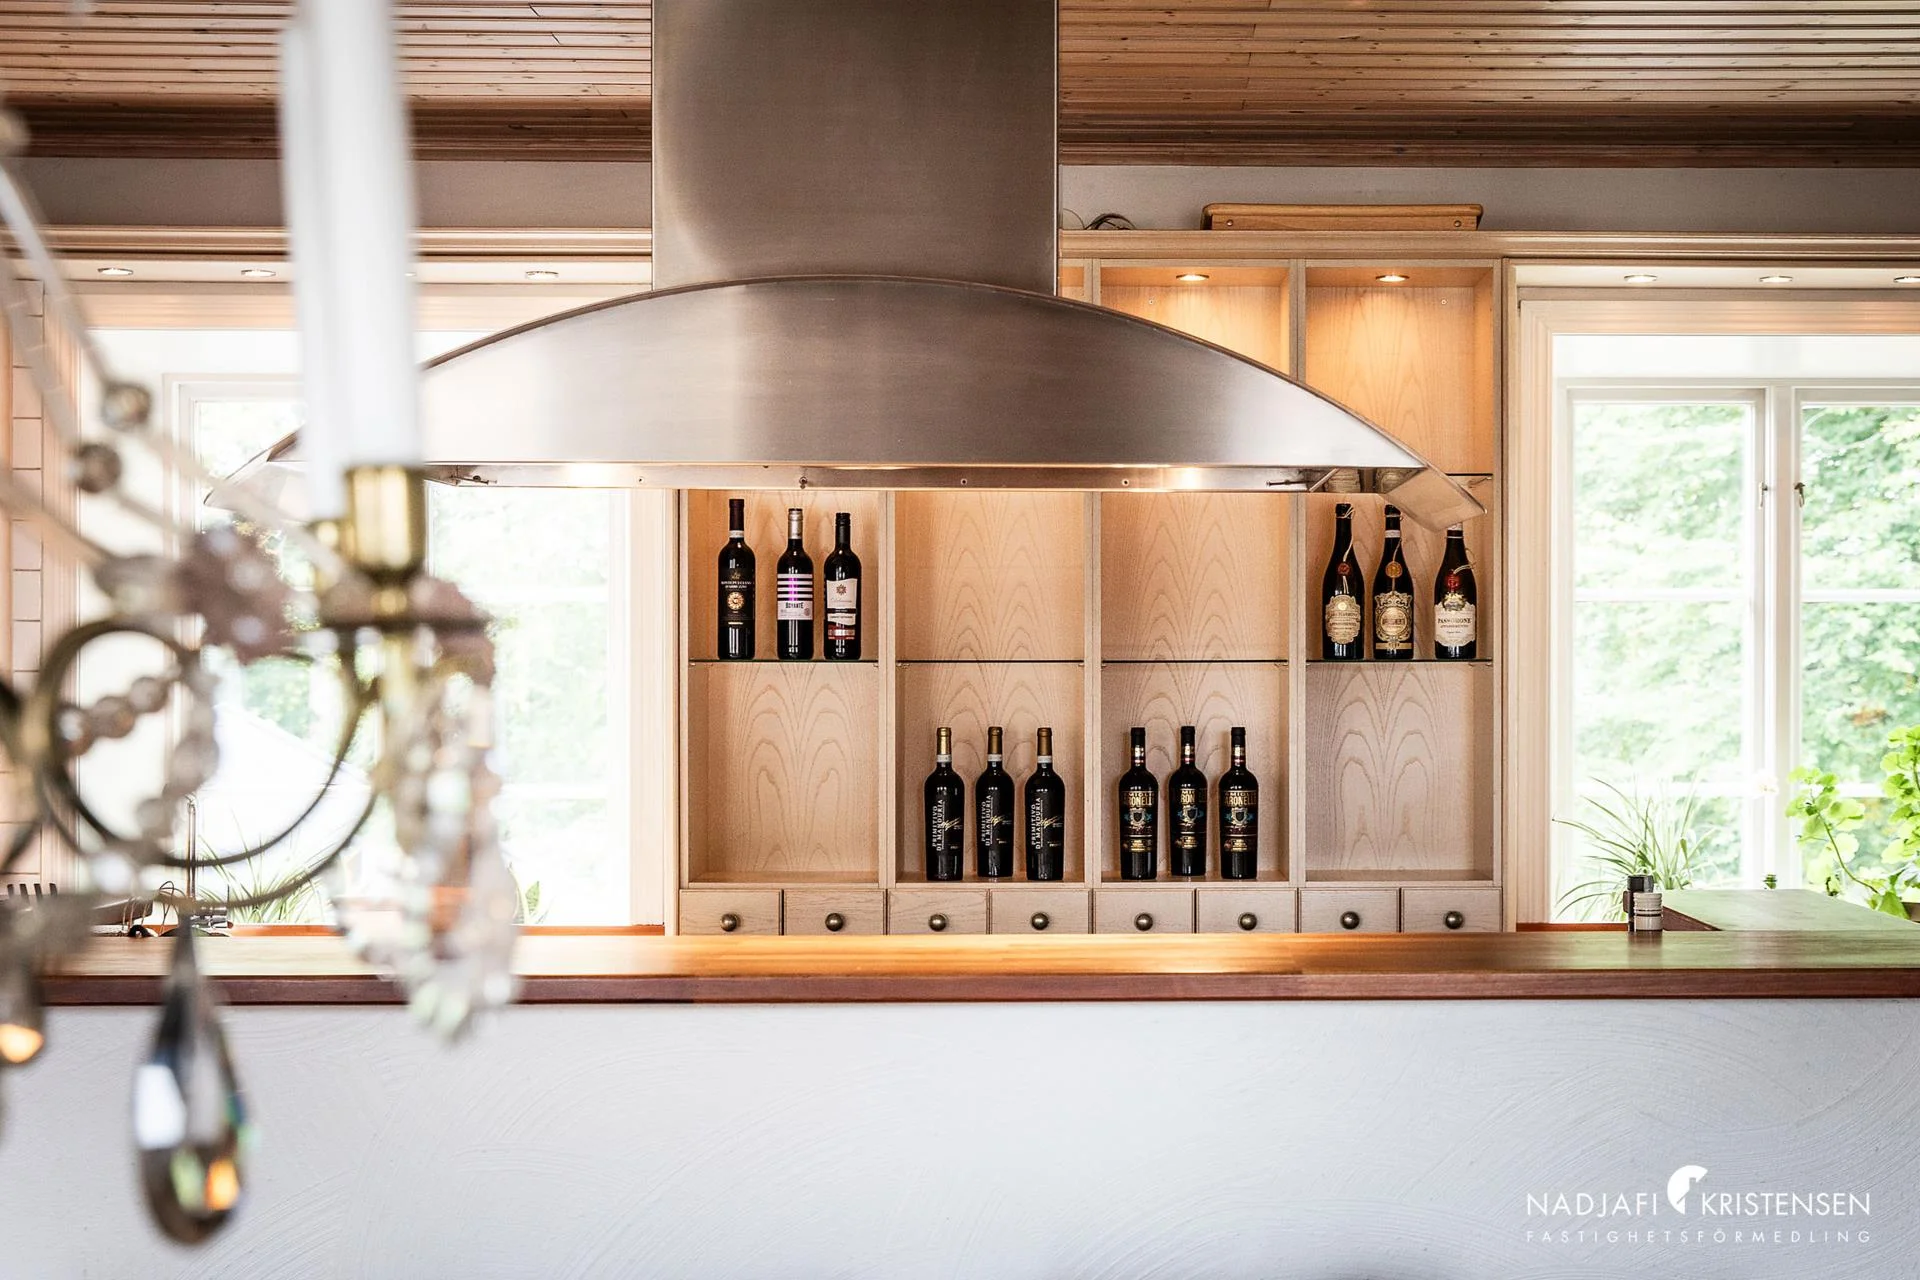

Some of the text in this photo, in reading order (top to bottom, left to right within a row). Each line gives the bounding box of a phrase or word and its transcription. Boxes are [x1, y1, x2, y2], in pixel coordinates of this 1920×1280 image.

[985, 838, 991, 846] DI
[1035, 841, 1041, 850] DI
[936, 843, 942, 851] DI
